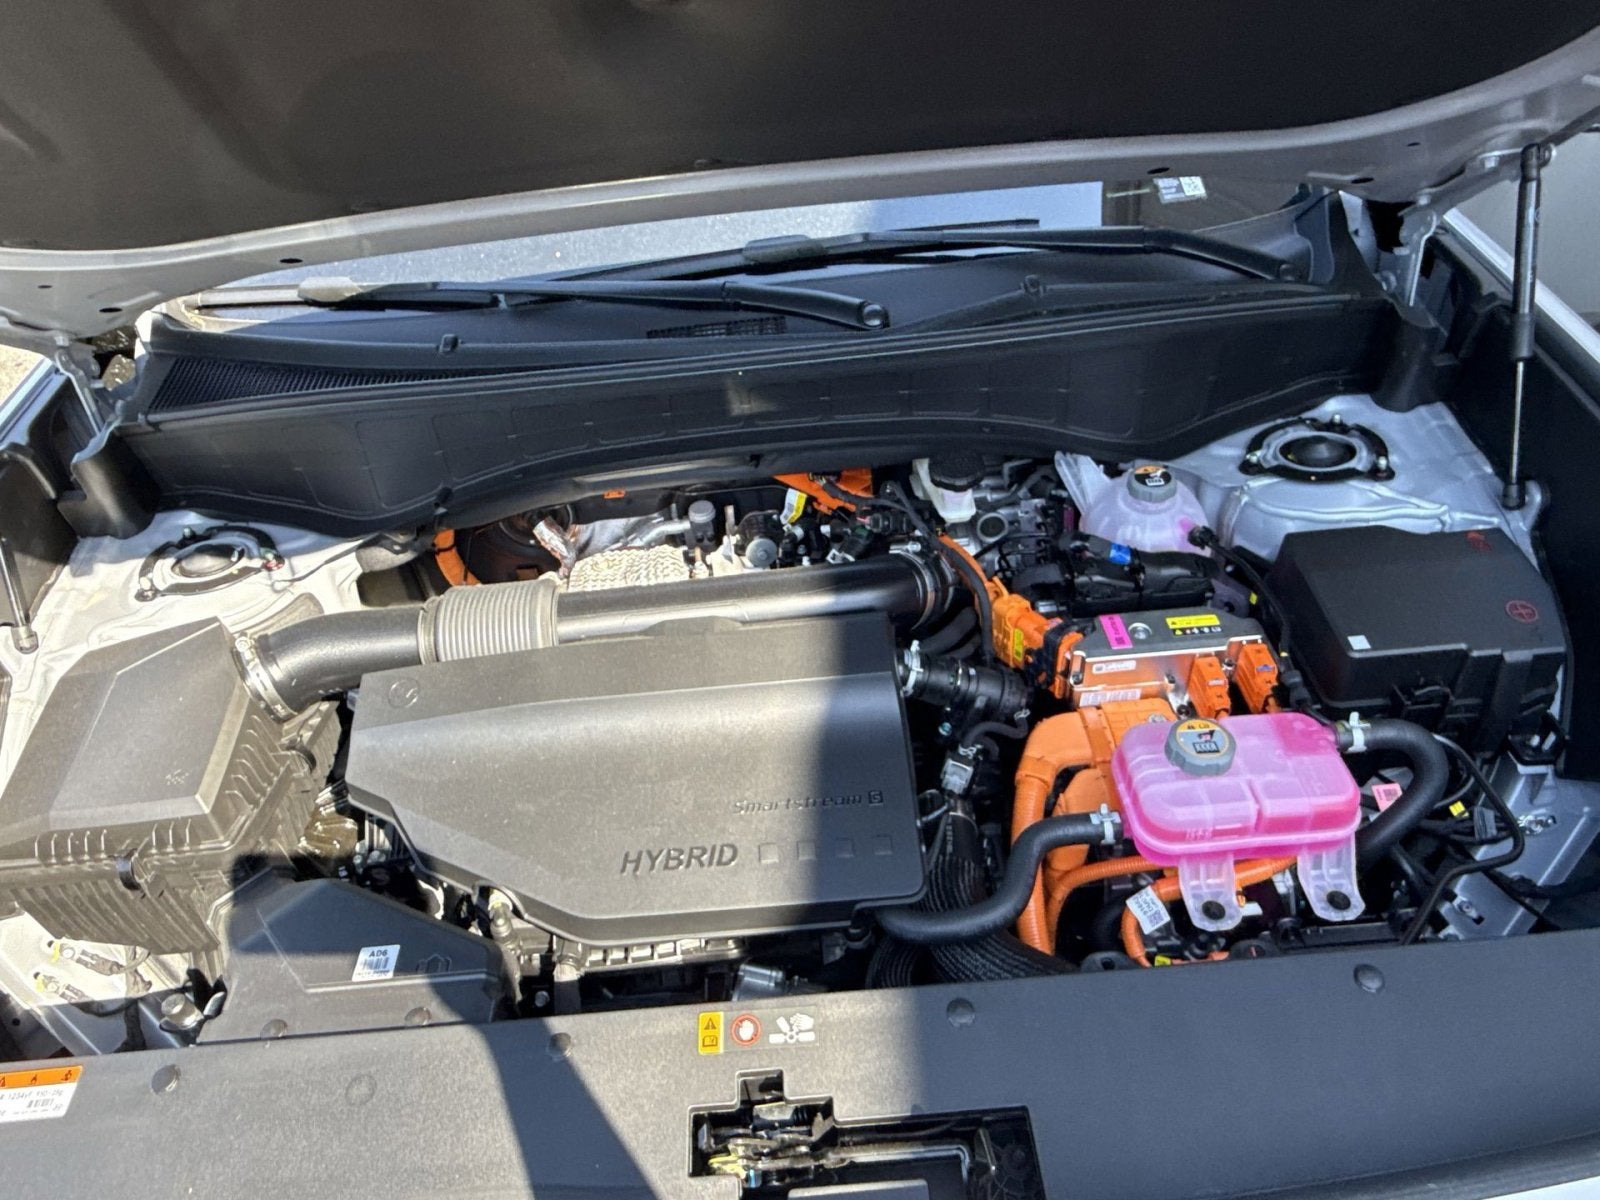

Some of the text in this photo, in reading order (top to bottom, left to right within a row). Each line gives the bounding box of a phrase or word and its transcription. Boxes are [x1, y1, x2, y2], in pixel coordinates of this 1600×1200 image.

[733, 794, 862, 813] Smartstream
[620, 843, 739, 875] HYBRID
[369, 949, 388, 958] AD6
